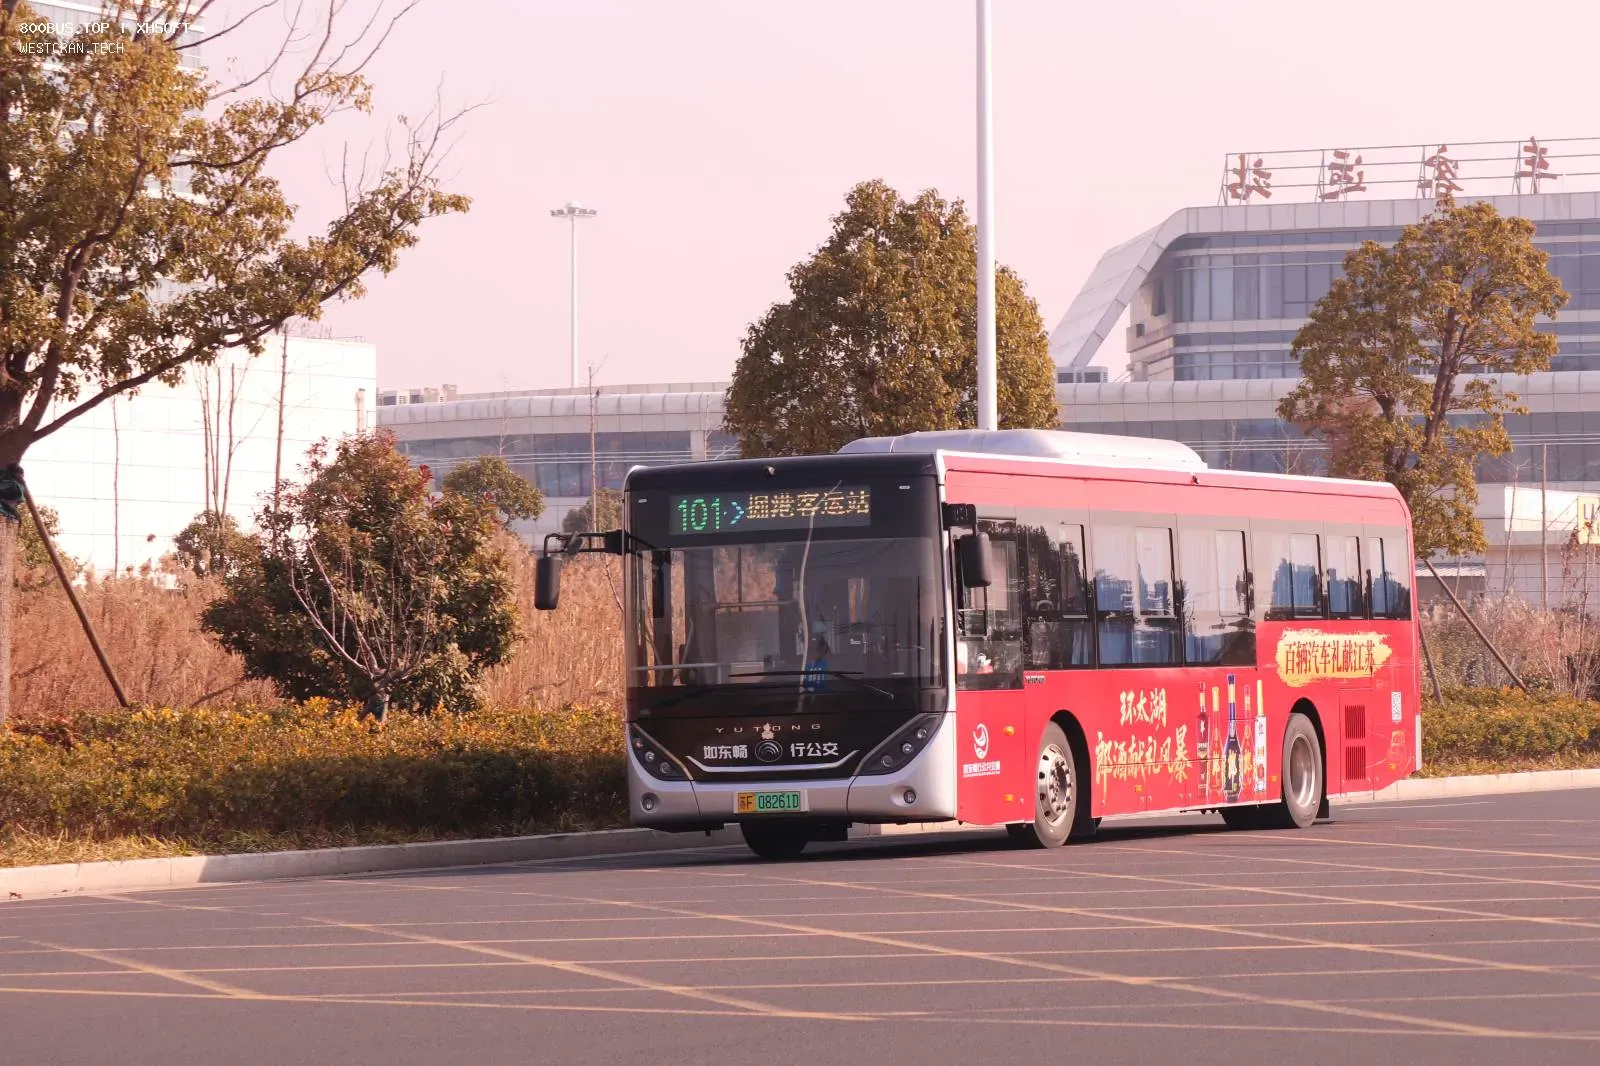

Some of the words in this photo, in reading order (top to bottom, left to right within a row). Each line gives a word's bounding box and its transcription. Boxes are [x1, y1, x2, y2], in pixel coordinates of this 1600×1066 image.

[678, 497, 720, 531] 101
[1285, 639, 1376, 675] 百辆汽车礼献江苏
[1119, 687, 1168, 729] 环太湖
[715, 723, 821, 734] YUTONG
[703, 744, 749, 760] 如东畅
[790, 742, 839, 758] 行公交
